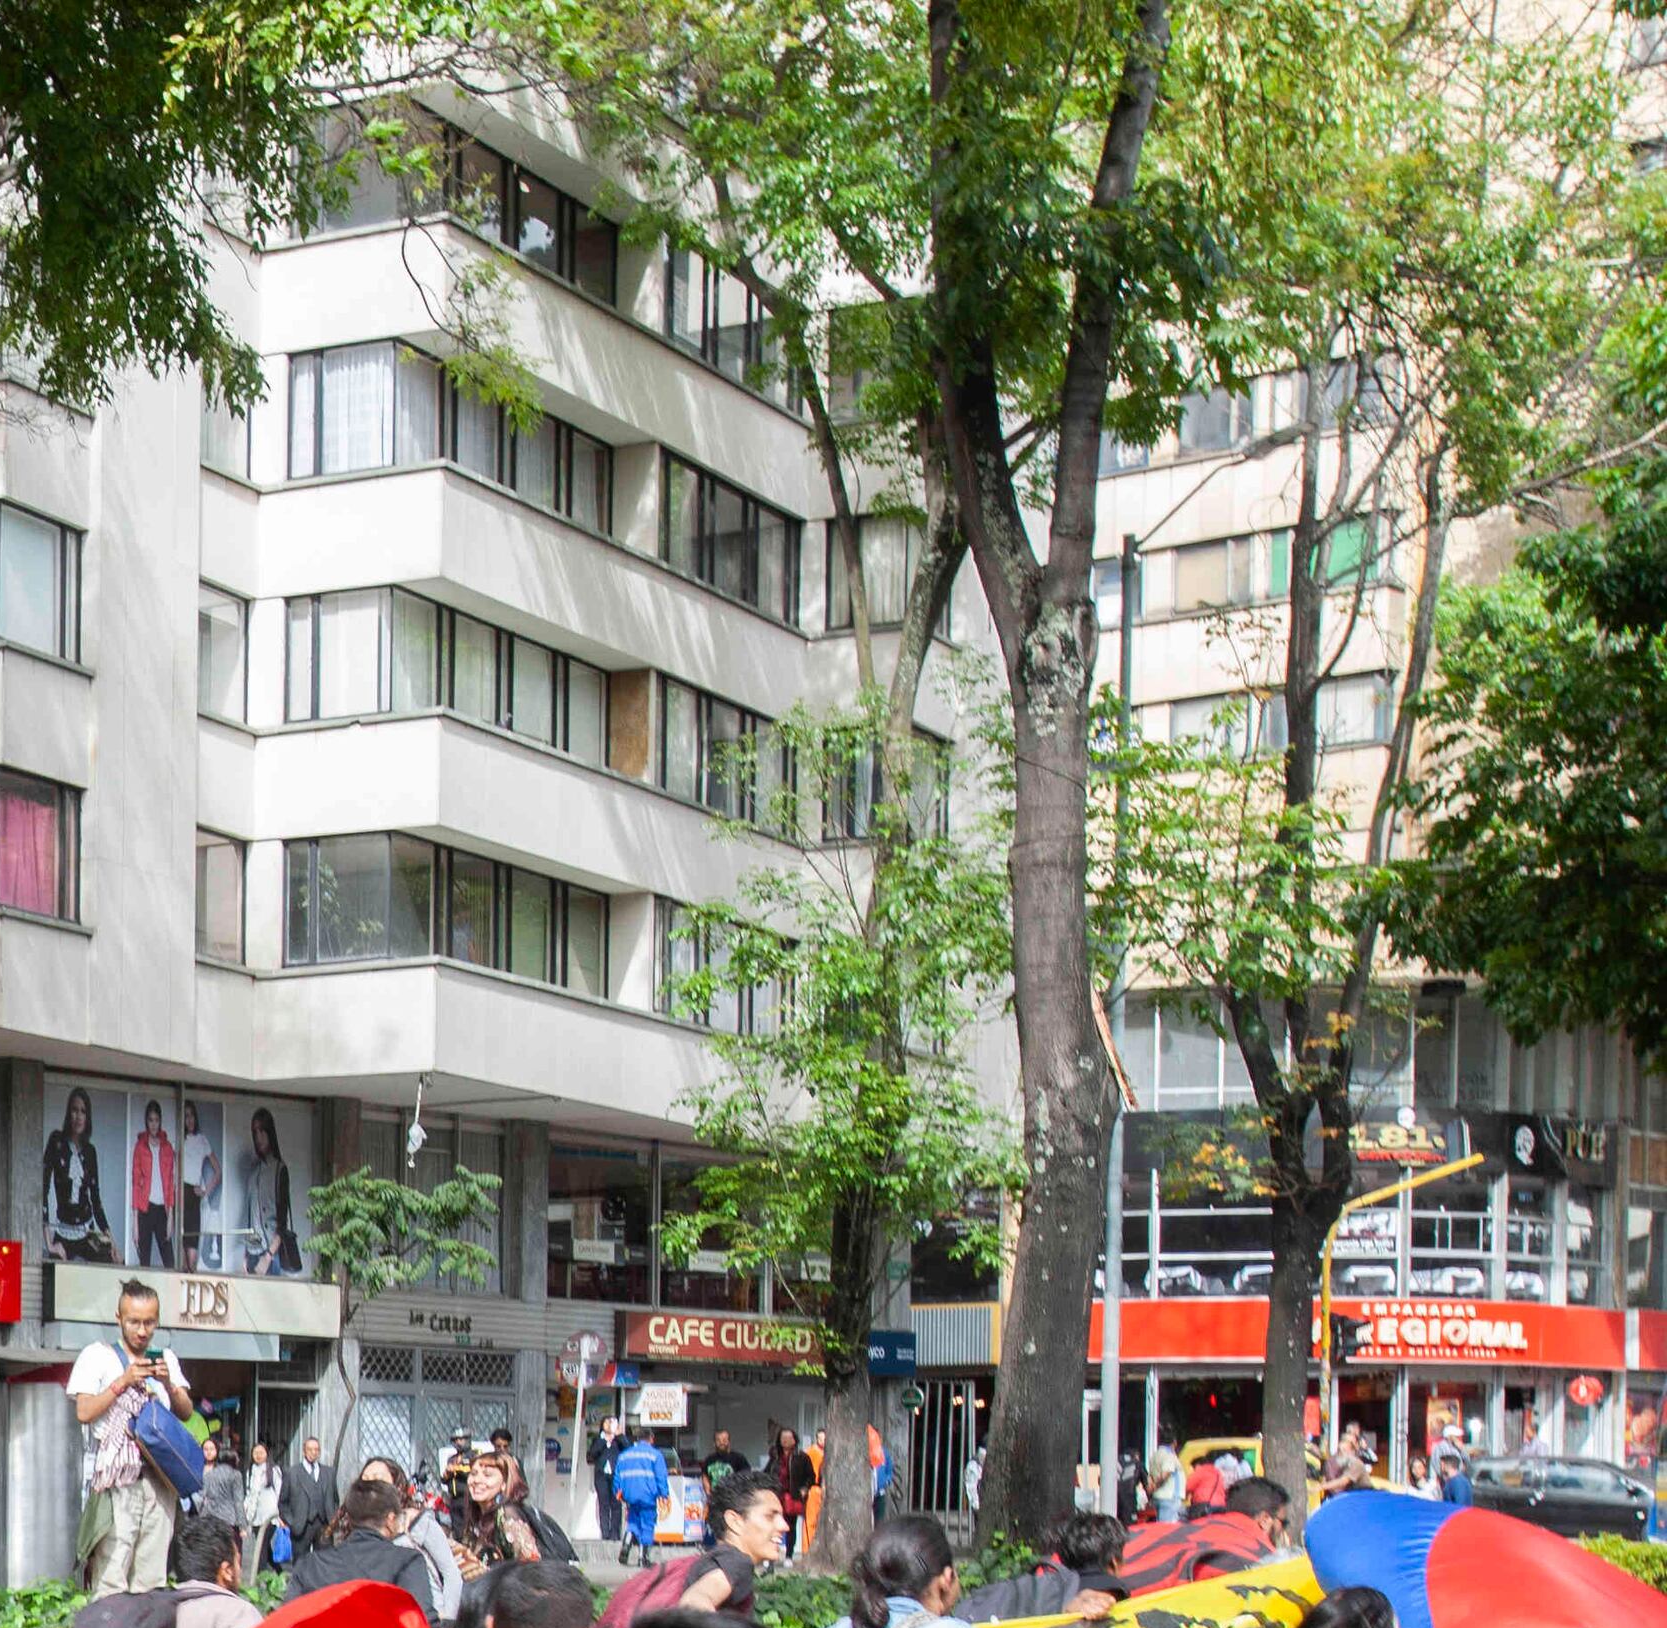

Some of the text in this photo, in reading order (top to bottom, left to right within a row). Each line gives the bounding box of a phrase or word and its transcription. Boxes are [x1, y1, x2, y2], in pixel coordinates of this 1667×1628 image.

[1361, 1302, 1477, 1319] EMPANADAS
[648, 1316, 715, 1347] CAFE
[1356, 1317, 1529, 1349] REGIONAL
